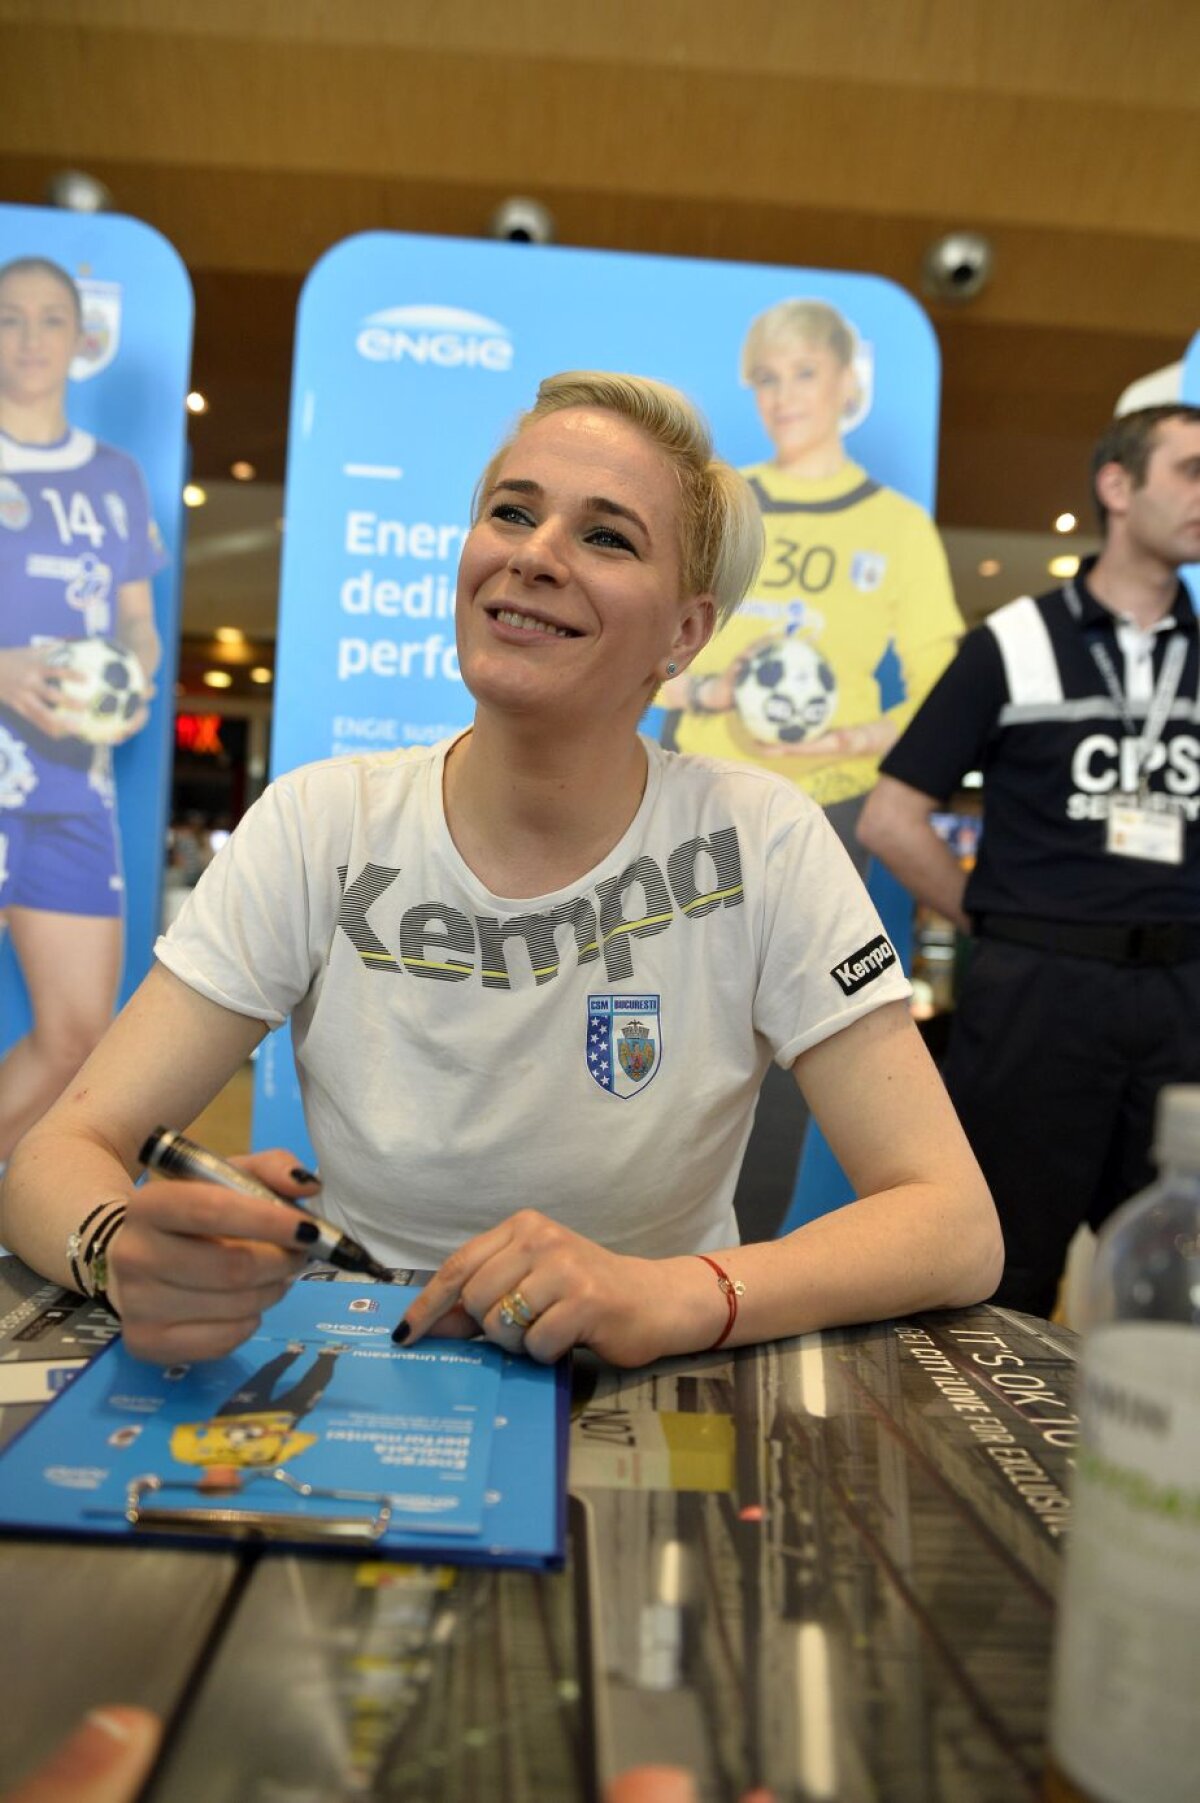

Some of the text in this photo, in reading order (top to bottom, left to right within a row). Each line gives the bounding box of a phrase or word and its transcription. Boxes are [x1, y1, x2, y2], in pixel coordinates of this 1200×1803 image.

[41, 488, 106, 548] 14
[345, 510, 471, 561] Ener
[763, 537, 836, 593] 30
[339, 570, 457, 619] dedi
[1071, 734, 1200, 795] CPS
[337, 826, 745, 990] Kempa
[835, 942, 893, 987] Kempa
[591, 1000, 656, 1010] CSM BUCURESTI
[894, 1328, 936, 1346] GET
[910, 1348, 959, 1374] CITY
[949, 1329, 1024, 1367] IT'S
[991, 1373, 1066, 1407] OK
[962, 1416, 1016, 1443] FOR
